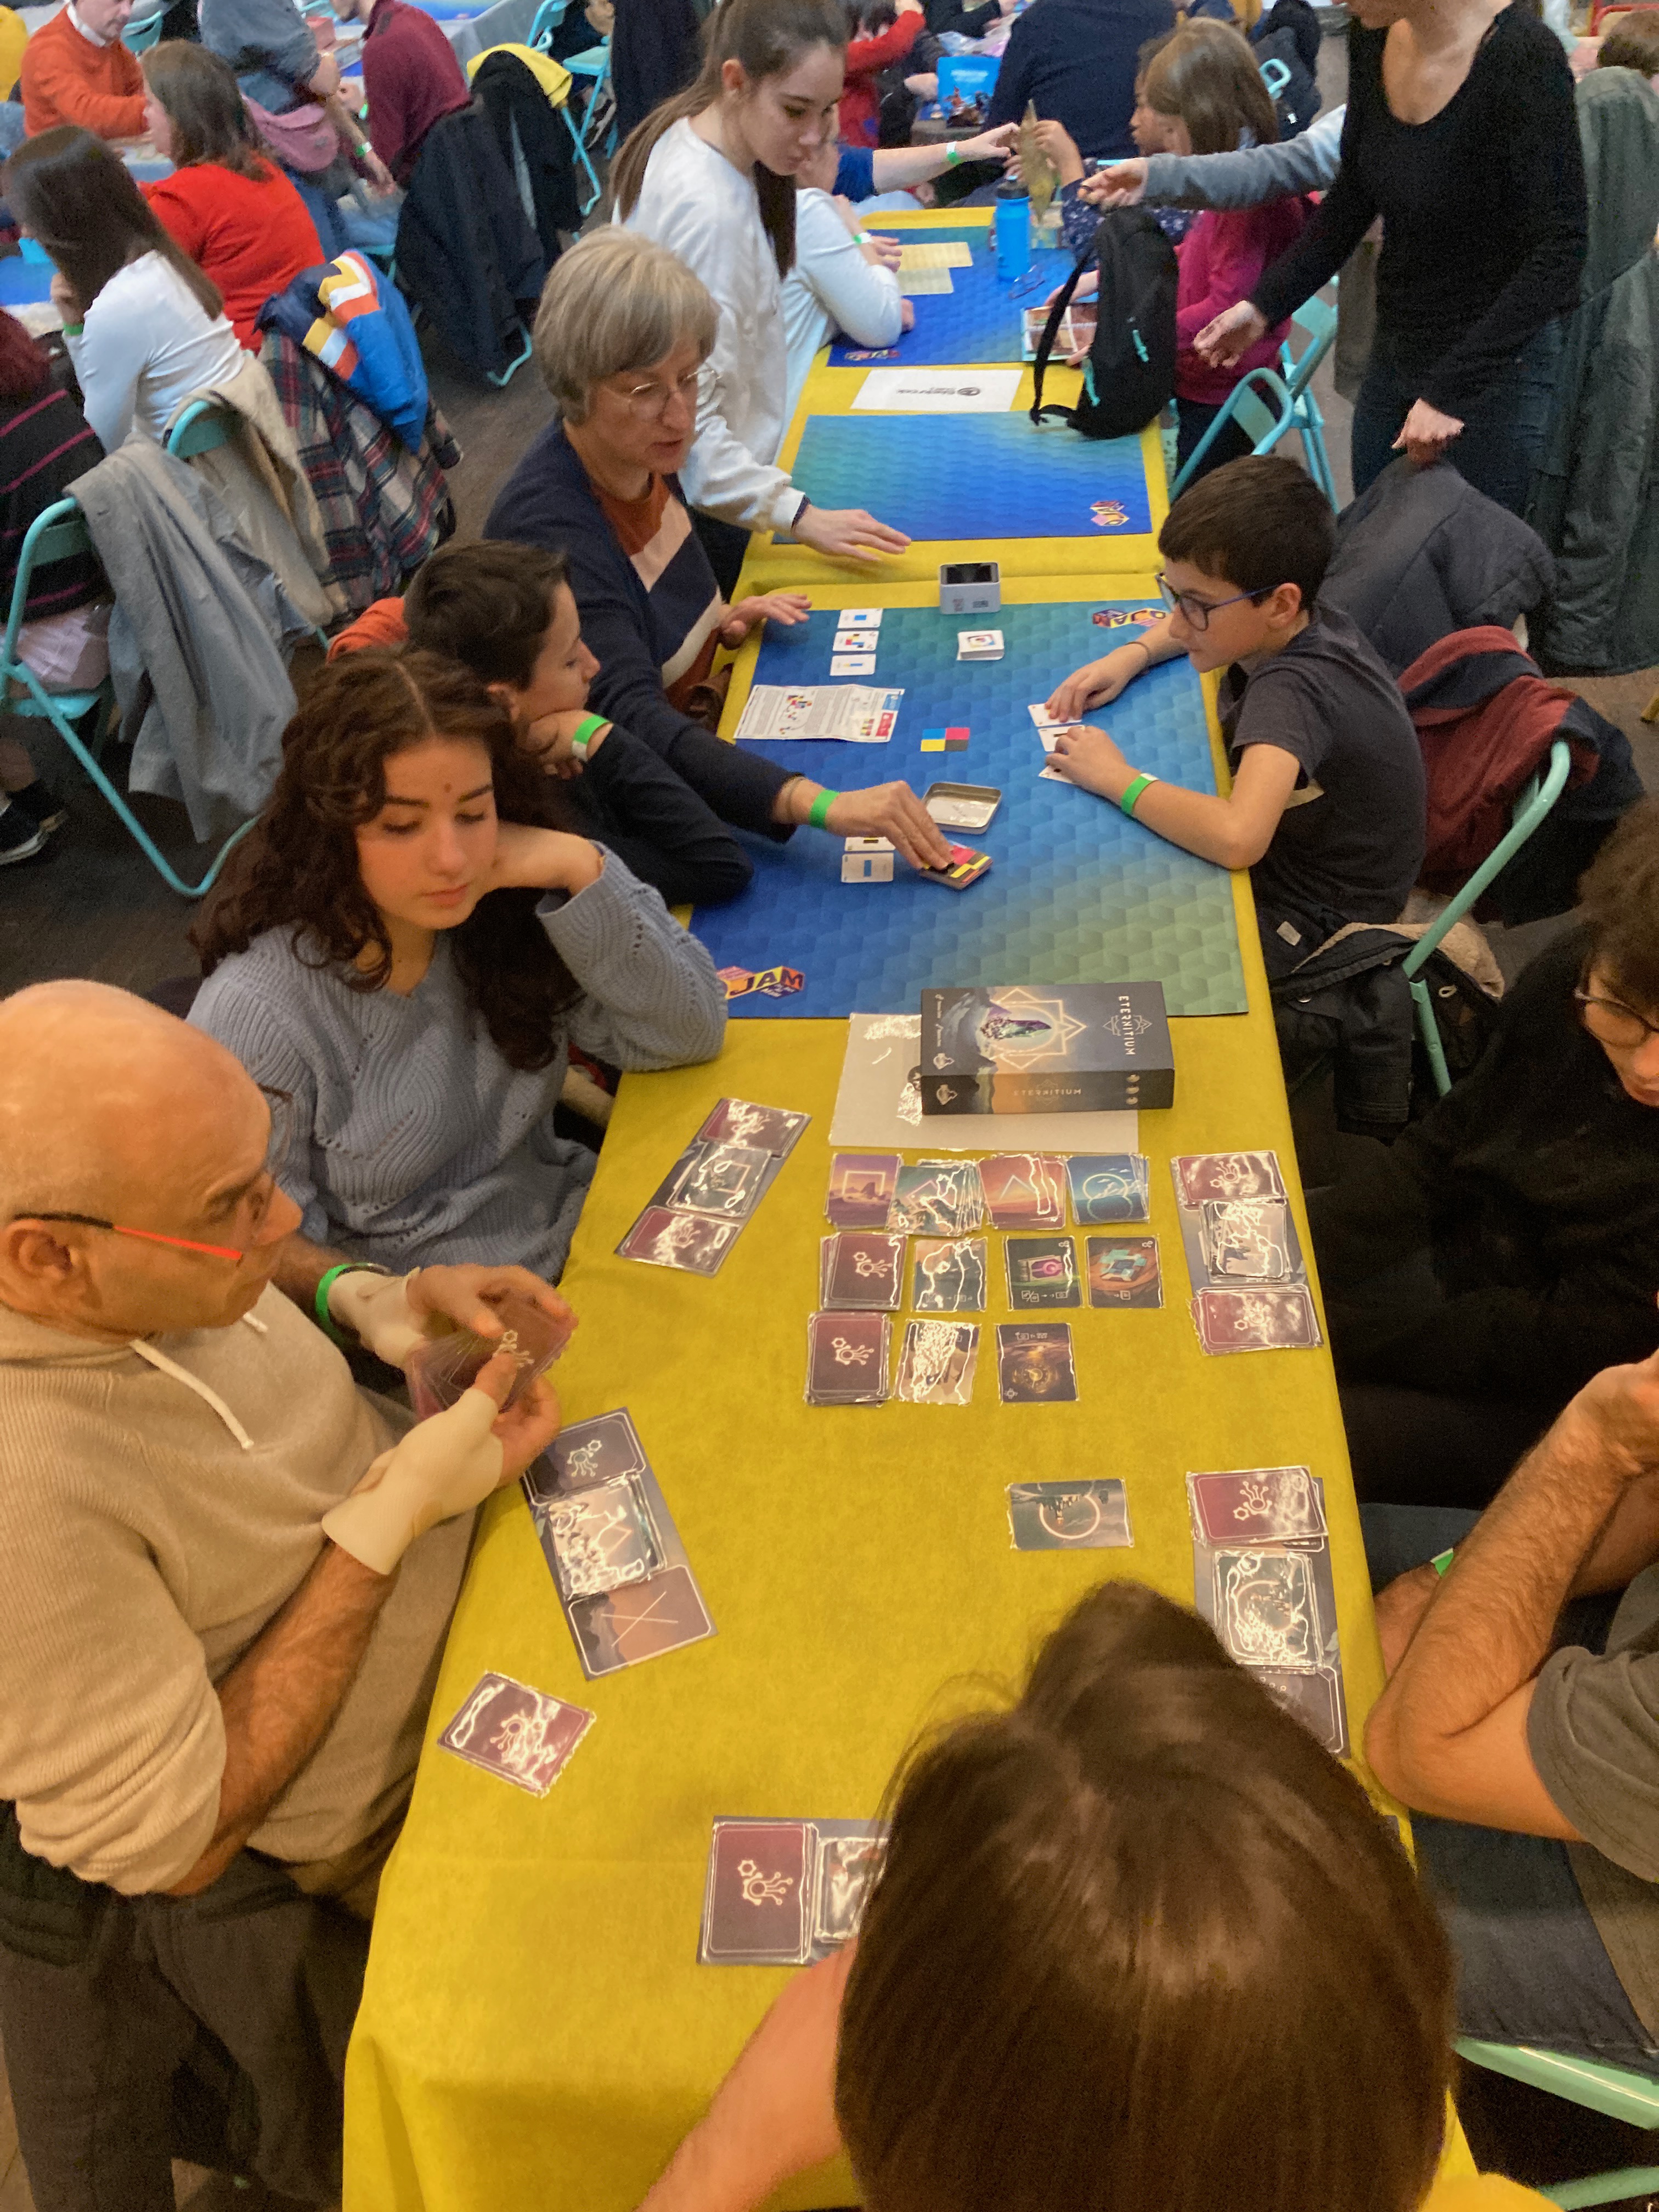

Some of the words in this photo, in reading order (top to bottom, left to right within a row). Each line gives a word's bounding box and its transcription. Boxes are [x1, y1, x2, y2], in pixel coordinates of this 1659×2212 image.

[723, 968, 804, 996] JAM
[1119, 996, 1136, 1055] ETERNITIUM
[1013, 1088, 1082, 1096] ETERNITIUM
